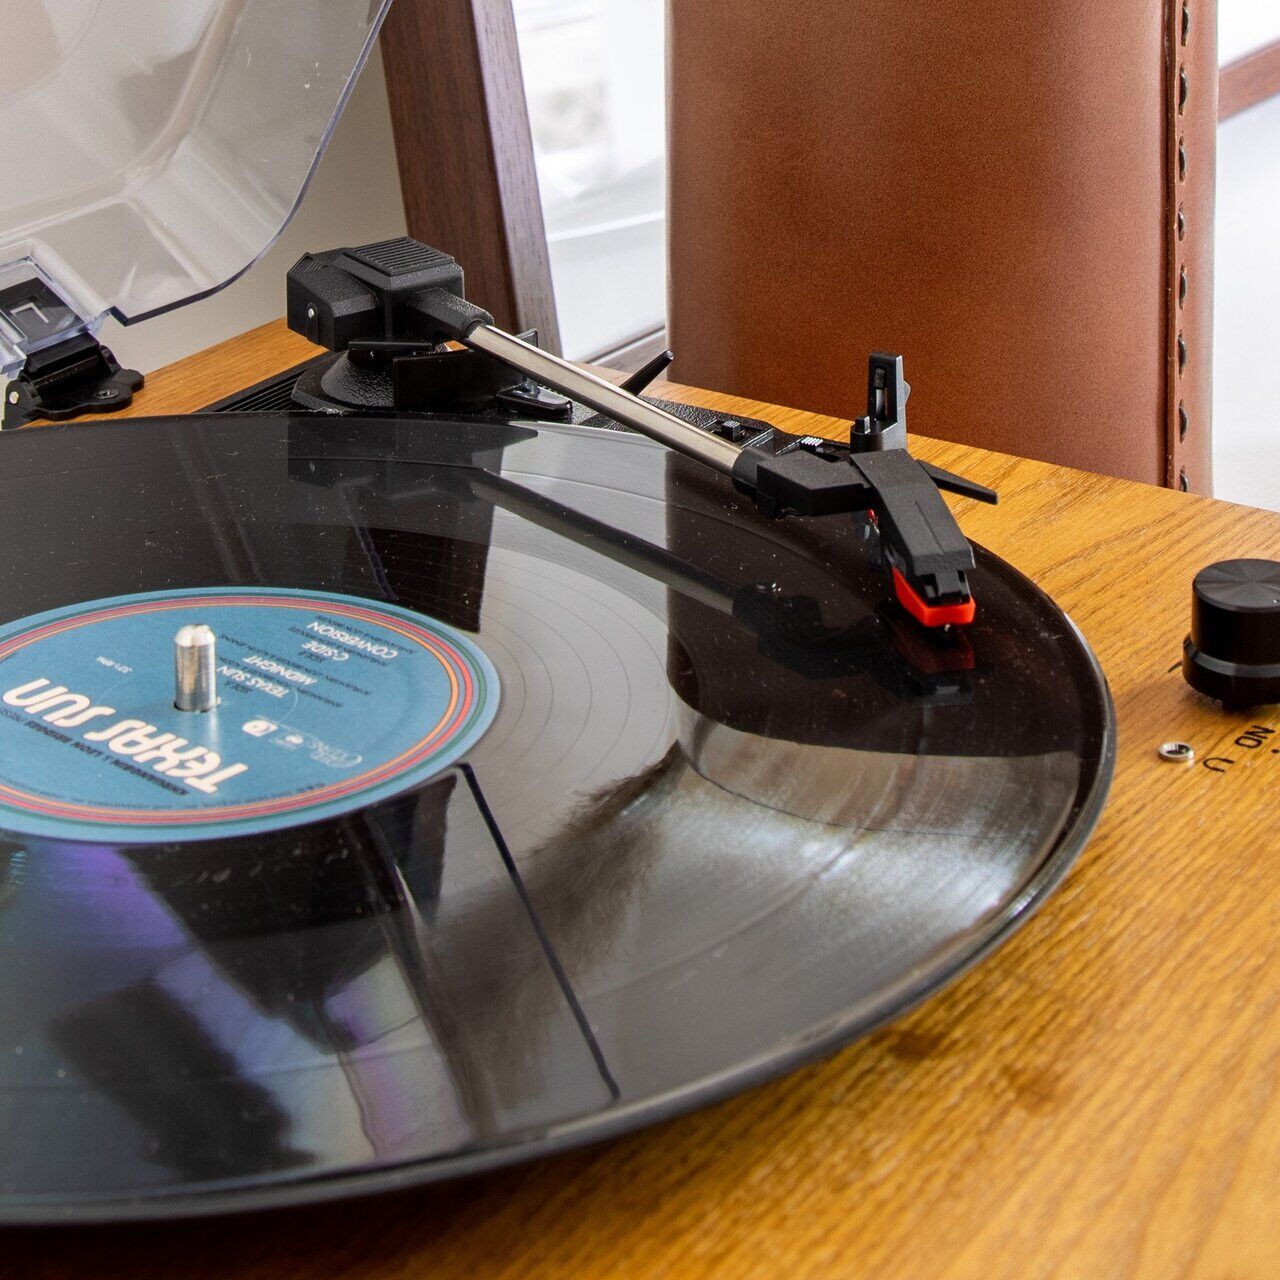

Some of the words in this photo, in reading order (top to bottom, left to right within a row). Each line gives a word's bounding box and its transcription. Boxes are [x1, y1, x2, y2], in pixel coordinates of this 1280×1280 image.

[301, 640, 350, 662] C-SIDE
[307, 621, 398, 659] CONVERSION
[217, 665, 251, 682] SUN
[243, 655, 317, 685] MIDNIGHT
[247, 677, 289, 698] TEXAS
[2, 678, 117, 728] SUN
[24, 721, 73, 744] BRIDGES
[1234, 724, 1277, 749] ON
[72, 740, 103, 758] LEON
[83, 719, 248, 794] TEXAS
[110, 758, 190, 796] KHRUANGBIN
